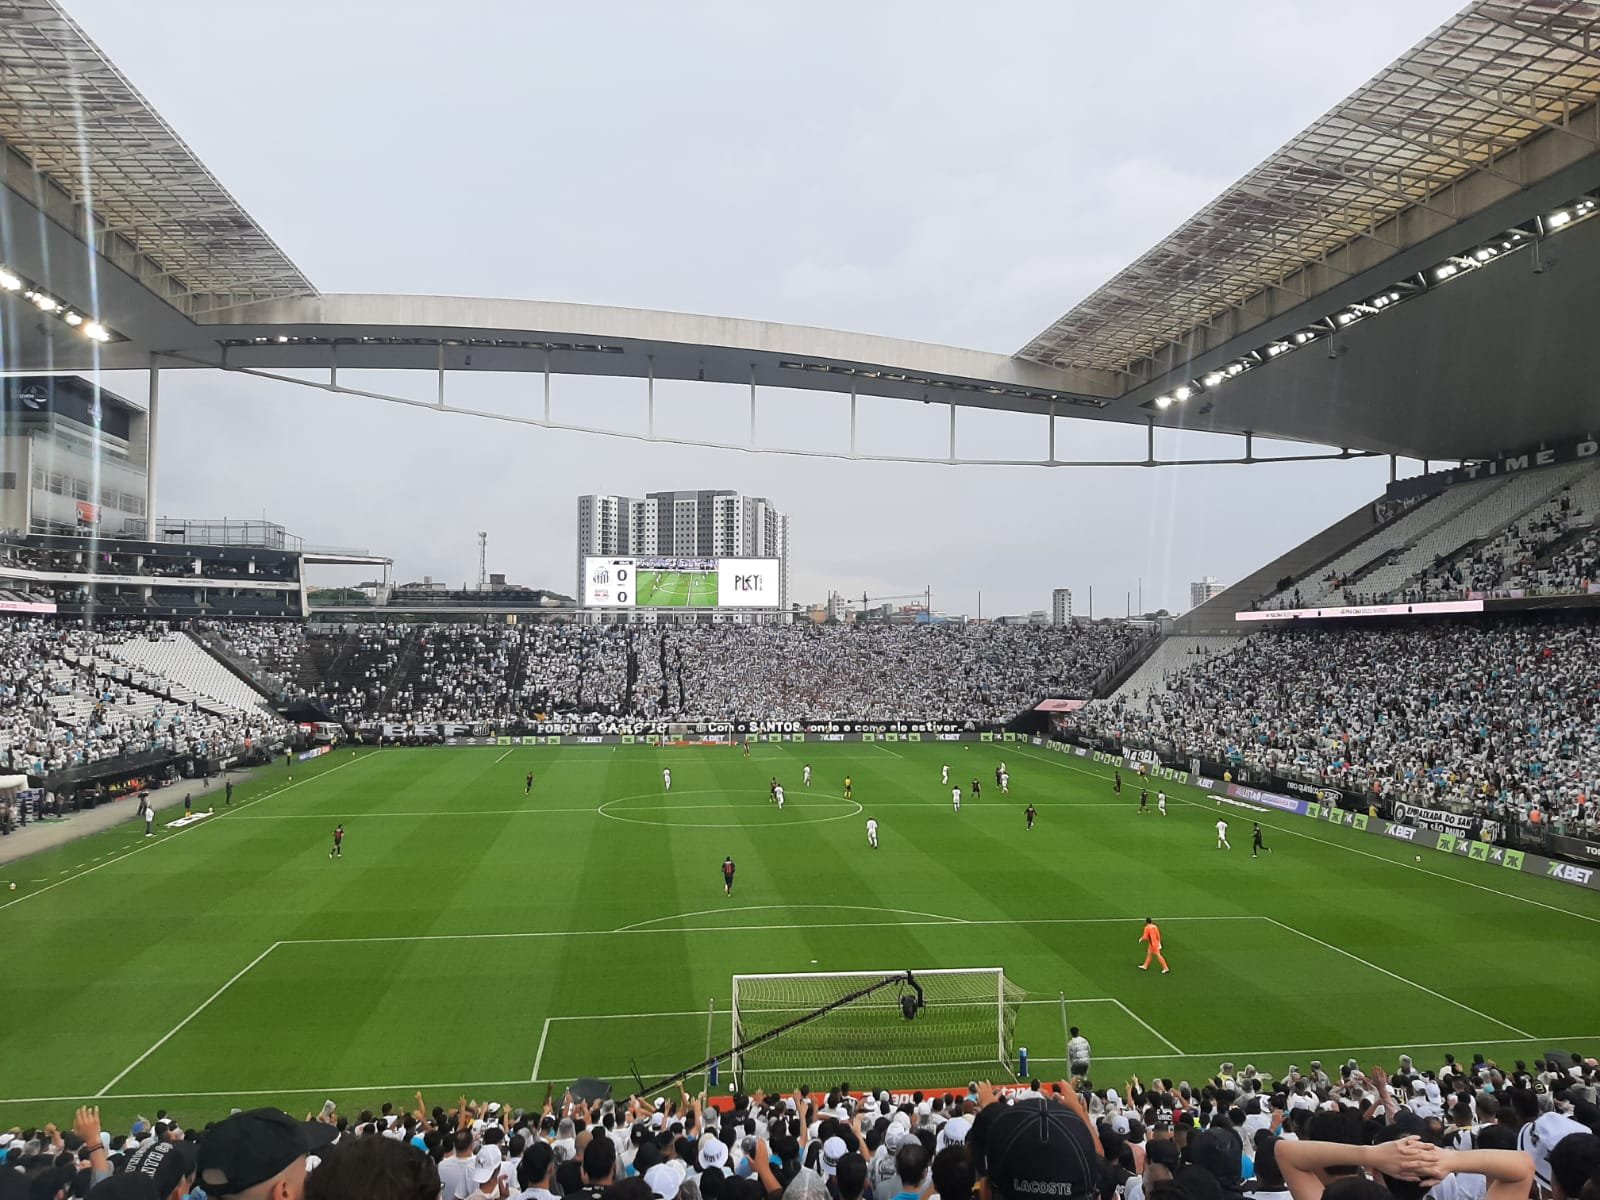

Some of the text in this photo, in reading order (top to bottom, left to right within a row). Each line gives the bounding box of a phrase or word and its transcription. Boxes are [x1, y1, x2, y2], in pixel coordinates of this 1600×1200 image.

[1464, 449, 1555, 479] TIME
[617, 569, 628, 582] 0
[617, 591, 628, 603] 0
[749, 721, 802, 733] SANTOS
[1445, 813, 1456, 824] DO
[1383, 822, 1417, 841] 7KBET
[1456, 839, 1469, 852] 7K
[1490, 847, 1503, 861] 7K
[1546, 861, 1594, 884] 7KBET
[1013, 1177, 1072, 1196] LACOSTE
